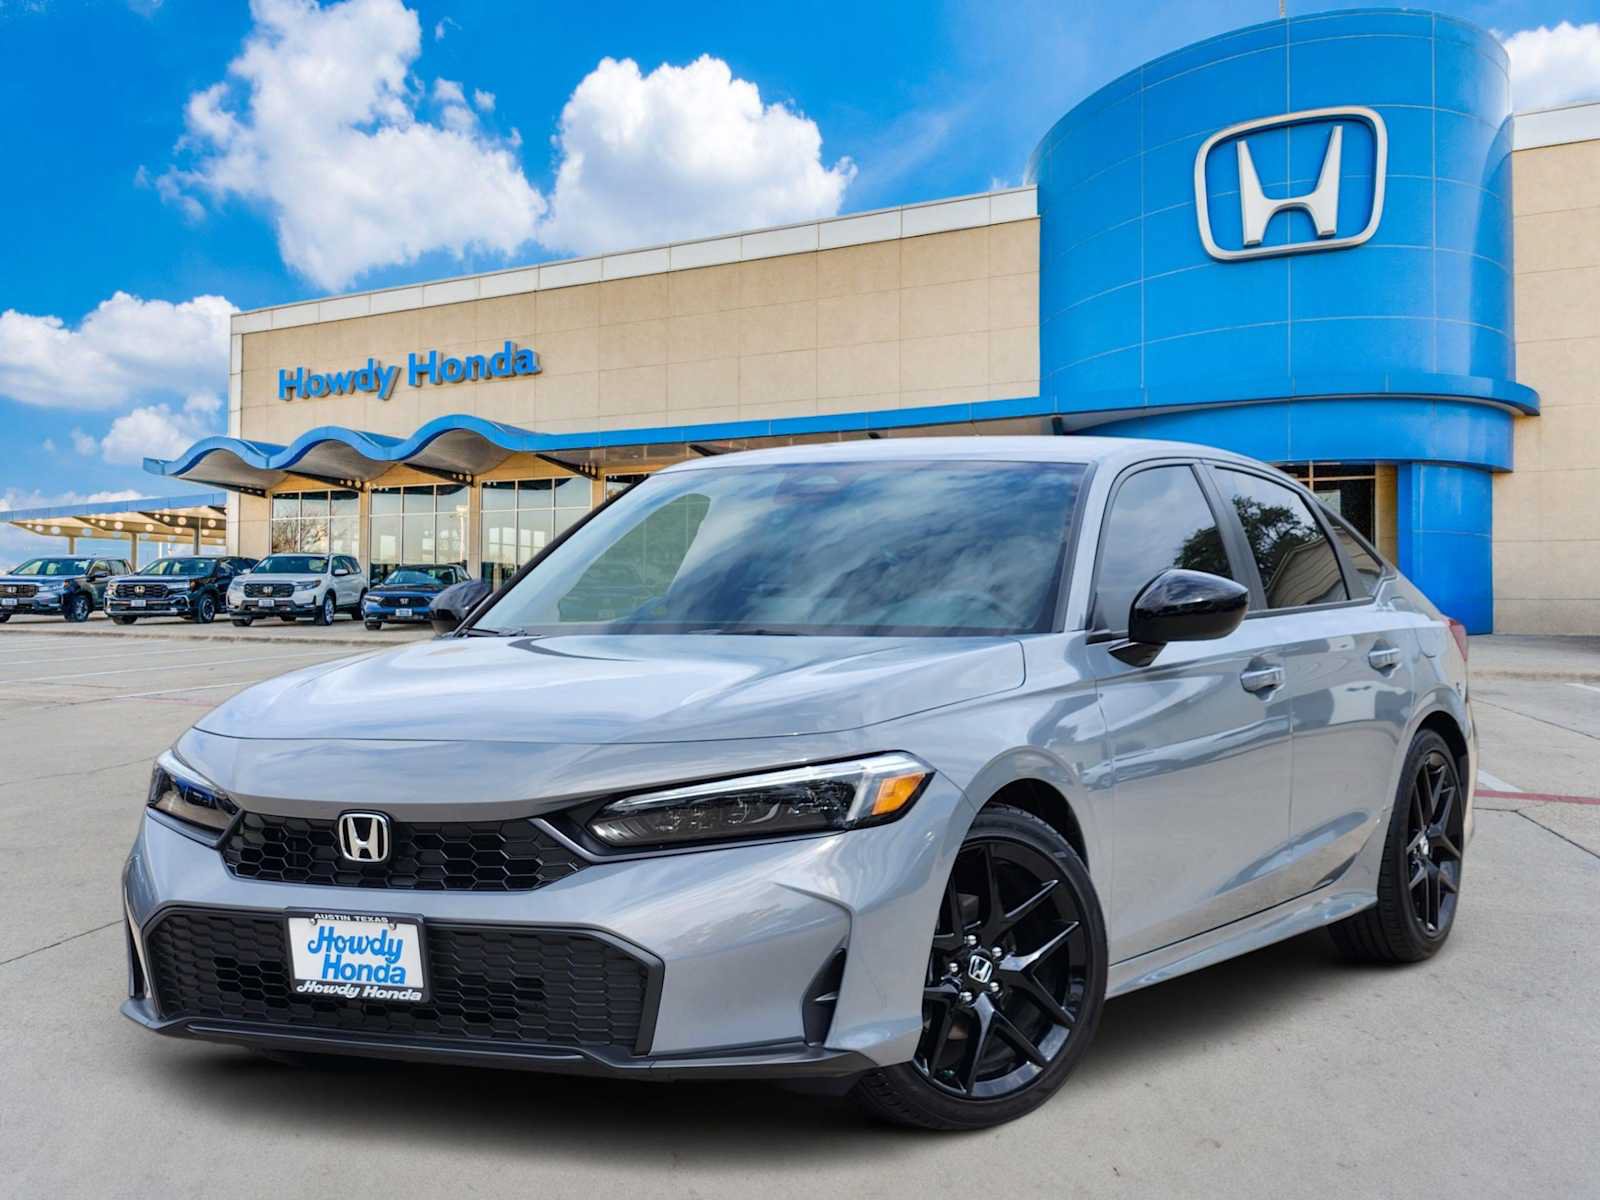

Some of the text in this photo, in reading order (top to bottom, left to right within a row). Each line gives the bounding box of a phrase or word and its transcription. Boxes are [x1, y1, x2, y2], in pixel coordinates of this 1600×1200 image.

[279, 340, 542, 400] Howdy Honda
[314, 913, 389, 923] AUSTIN TEXAS
[307, 925, 403, 963] Howdy
[322, 953, 406, 984] Honda
[296, 981, 422, 1000] Howdy Honda
